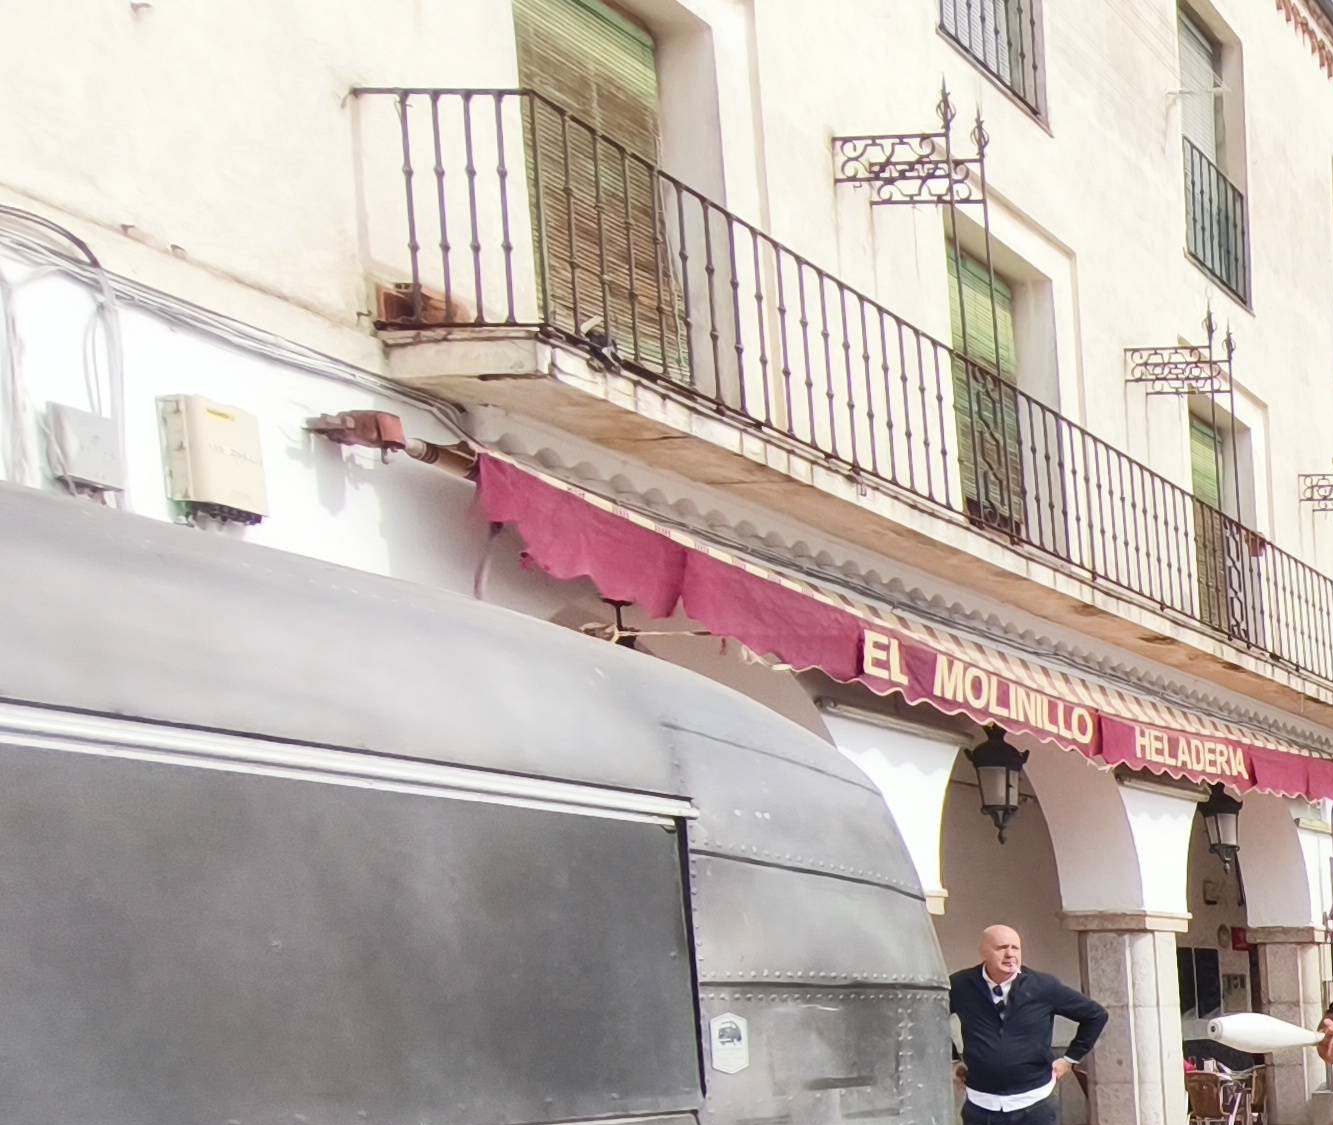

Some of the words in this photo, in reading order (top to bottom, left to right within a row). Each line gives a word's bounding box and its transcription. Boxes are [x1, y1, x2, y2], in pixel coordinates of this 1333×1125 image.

[863, 628, 909, 686] EL
[932, 653, 1093, 743] MOLINILLO
[1135, 725, 1249, 780] HELADERIA
